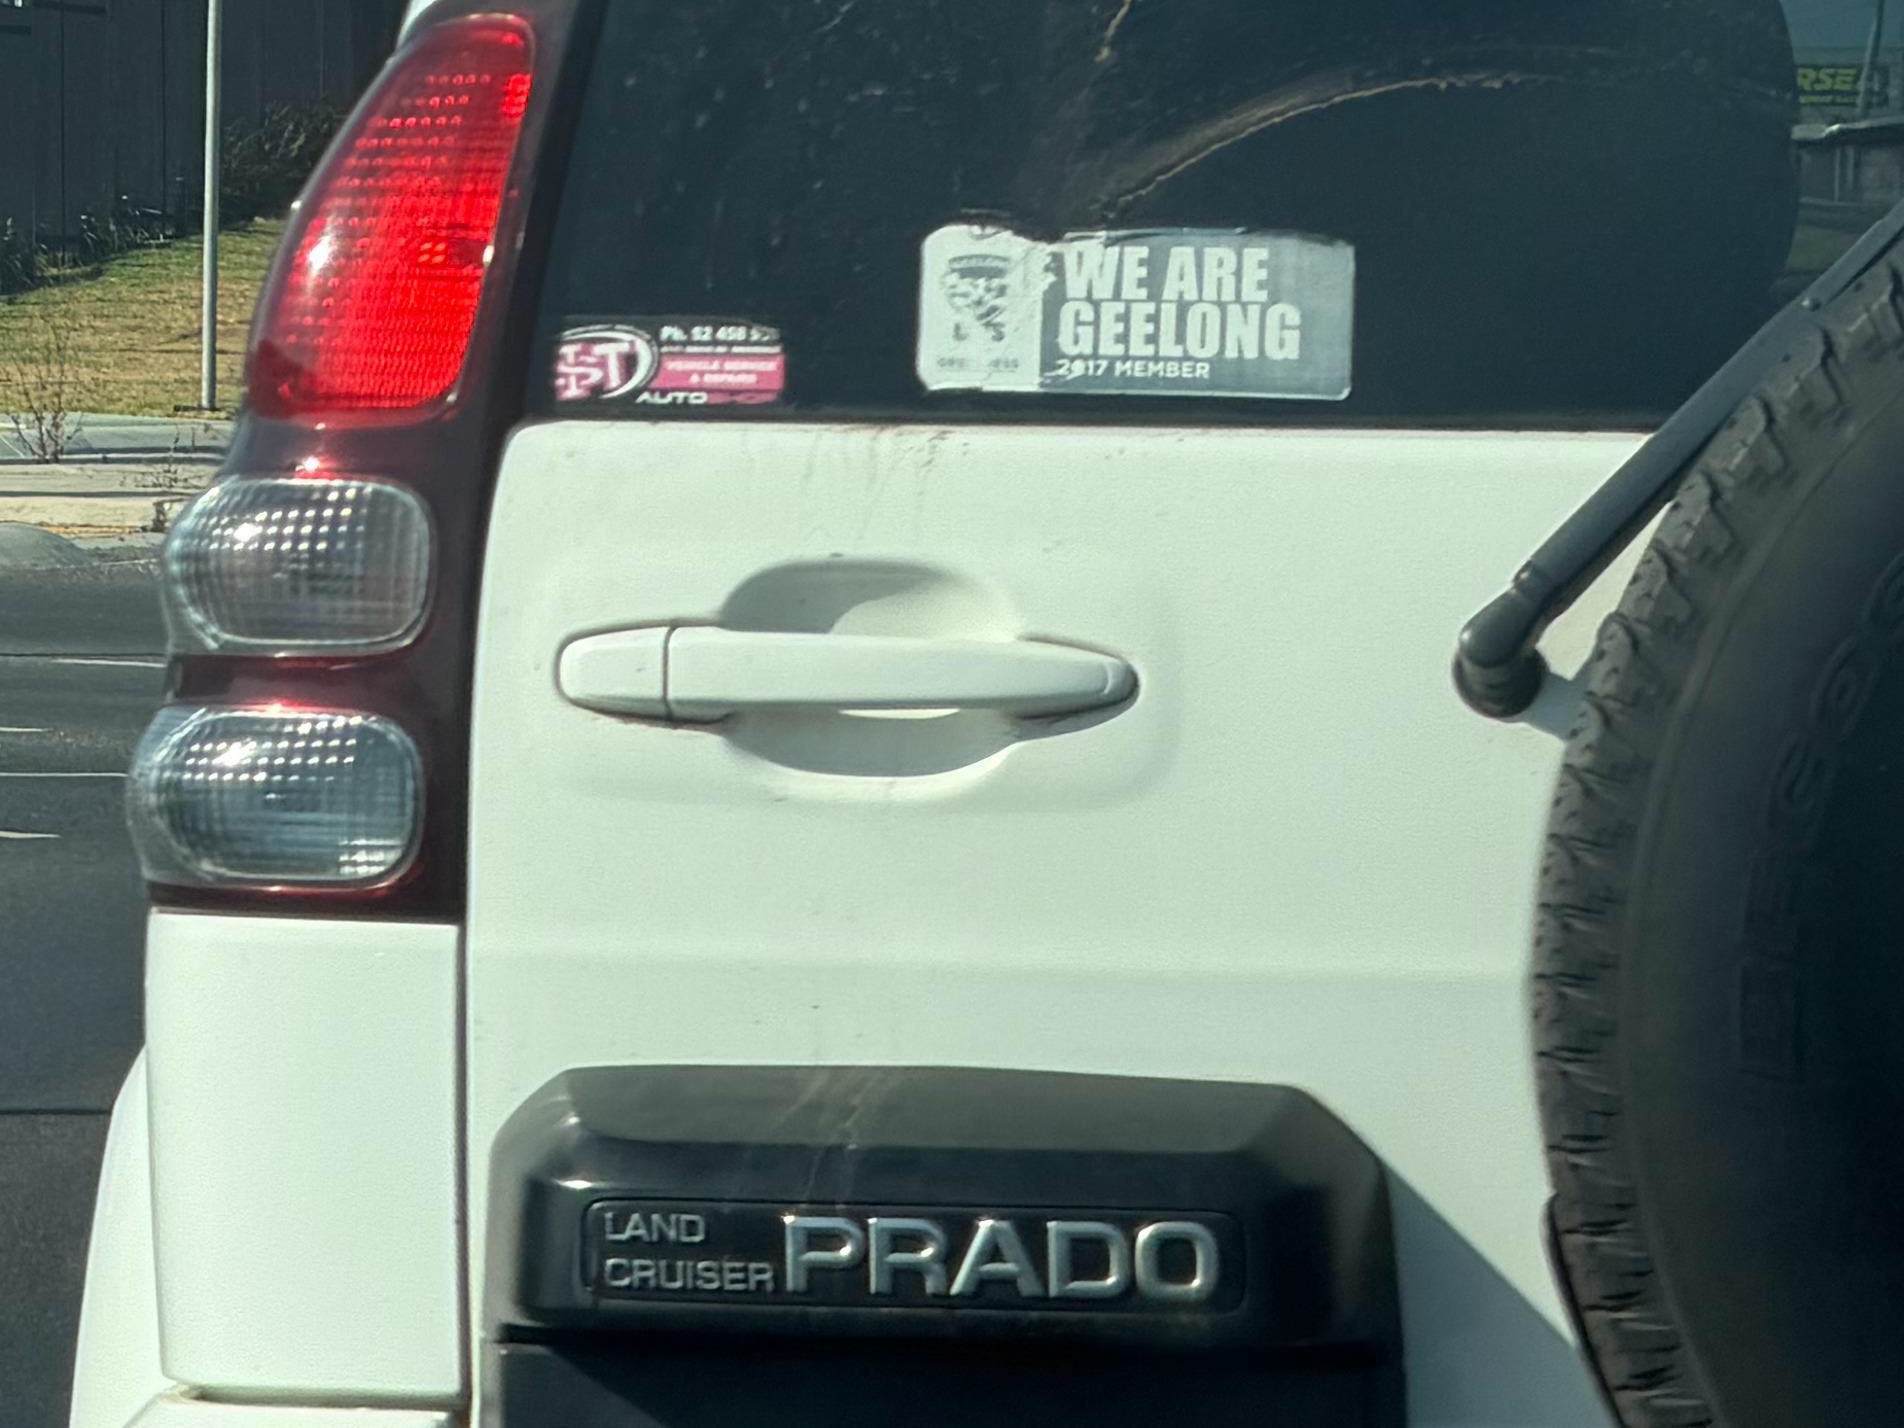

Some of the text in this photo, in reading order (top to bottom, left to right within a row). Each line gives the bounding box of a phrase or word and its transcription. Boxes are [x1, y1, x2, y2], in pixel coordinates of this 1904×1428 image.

[1063, 246, 1269, 302] WE ARE
[1057, 300, 1302, 360] GEELONG
[1057, 358, 1211, 379] 2017 MEMBER
[604, 1211, 706, 1244] LAND
[603, 1256, 777, 1294] CRUISER
[783, 1214, 1220, 1301] PRADO
